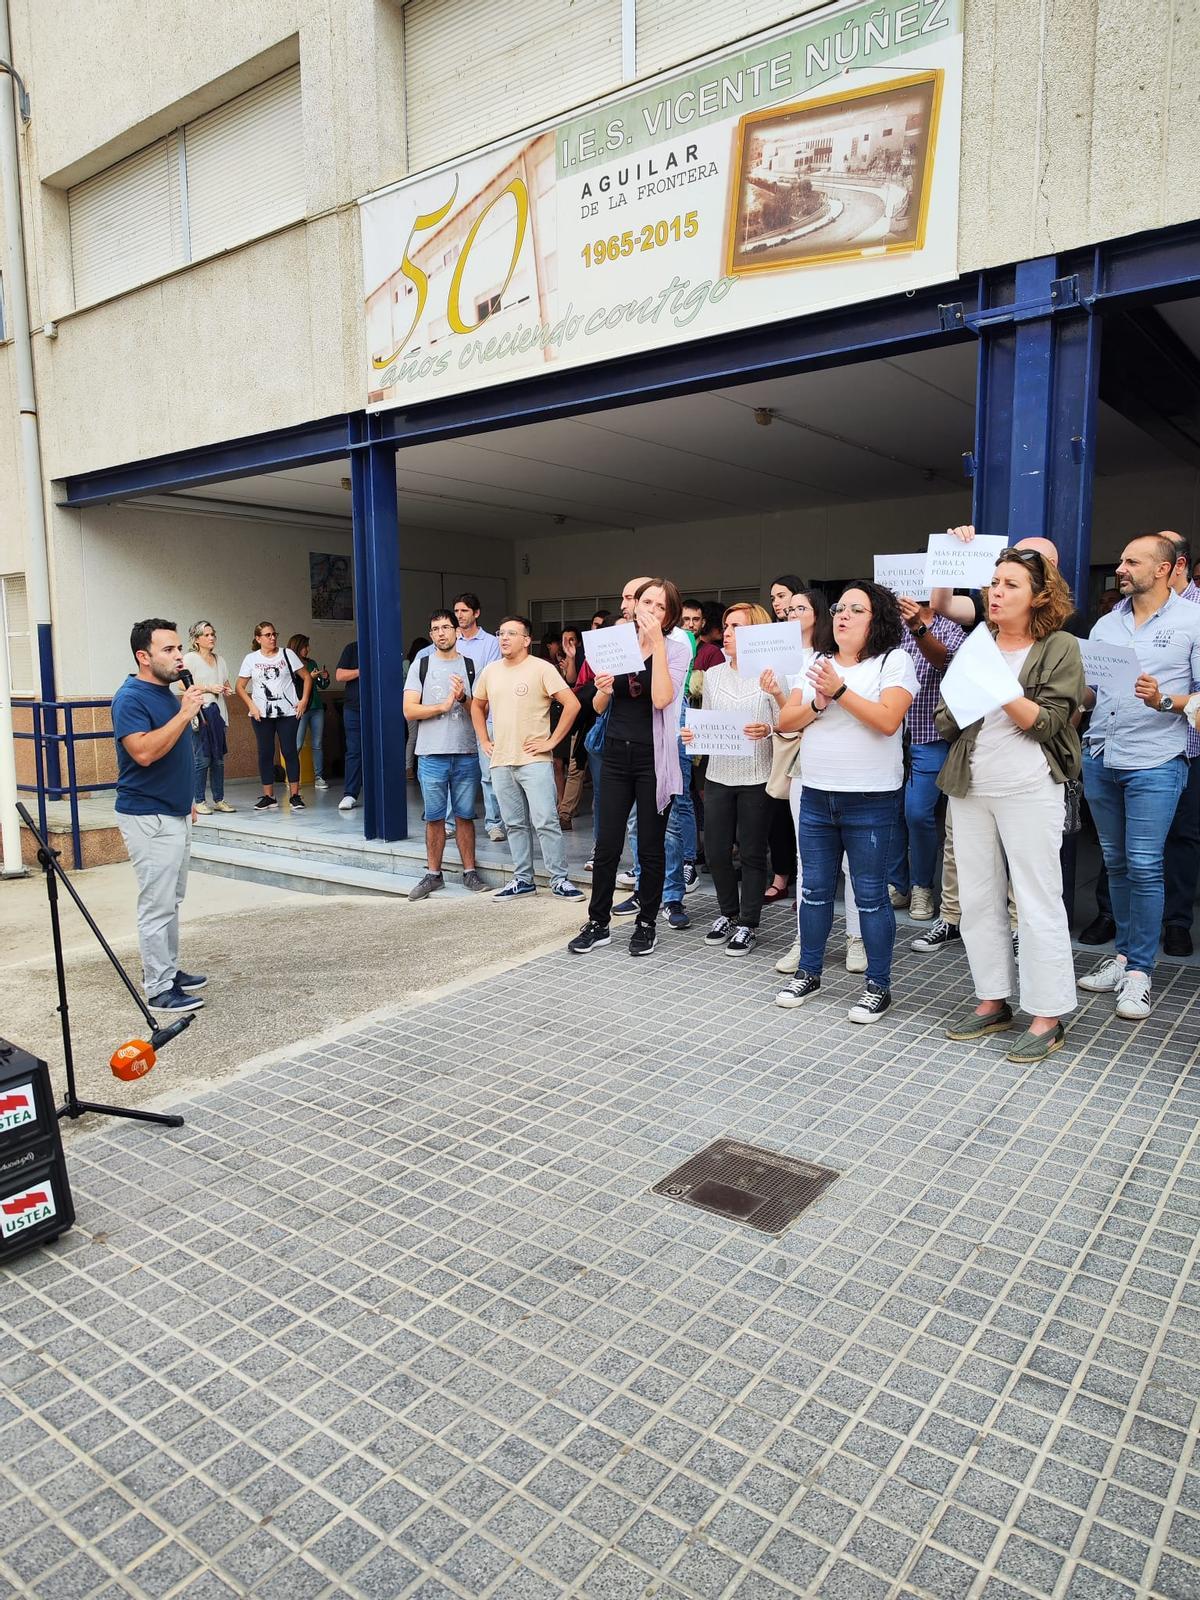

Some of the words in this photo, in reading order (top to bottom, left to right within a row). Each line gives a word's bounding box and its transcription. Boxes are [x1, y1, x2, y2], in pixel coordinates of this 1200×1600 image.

[562, 118, 633, 169] I.E.S.
[642, 51, 792, 136] VICENTE
[805, 0, 949, 78] NÚÑEZ
[581, 144, 699, 200] AGUILAR
[581, 201, 600, 220] DE
[608, 192, 628, 211] LA
[637, 161, 720, 201] FRONTERA
[580, 210, 700, 269] 1965-2015
[371, 172, 530, 370] 50
[379, 350, 453, 388] años
[458, 301, 585, 370] creciendo
[584, 275, 741, 336] contigo
[900, 579, 924, 587] VEND
[952, 550, 994, 558] RECURSOS
[6, 1205, 52, 1233] USTEA
